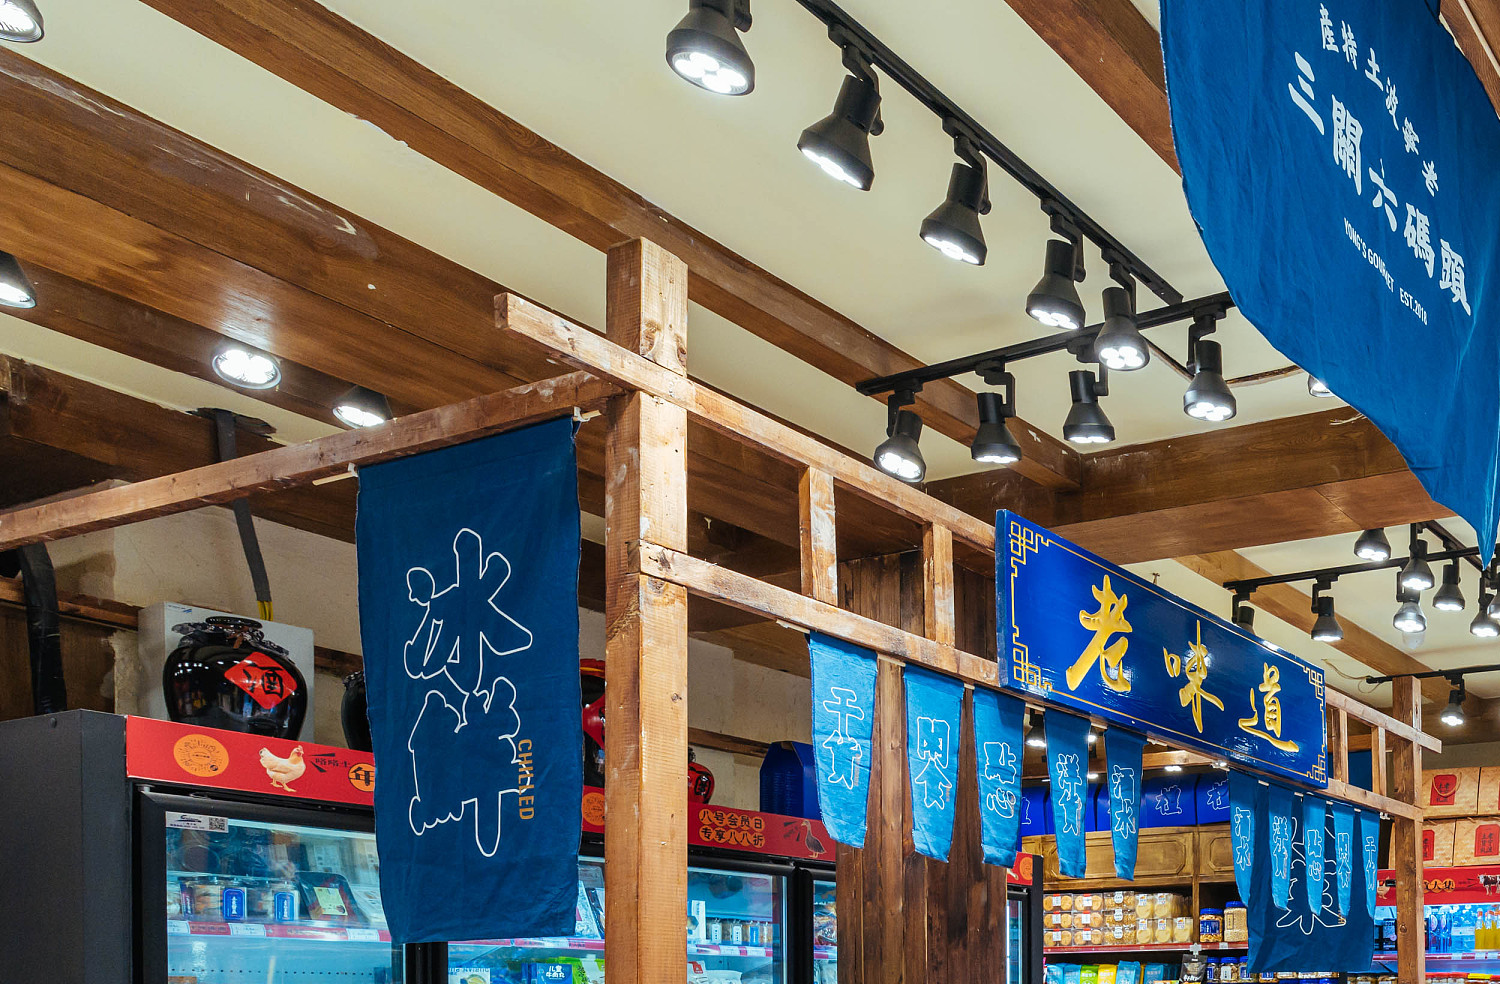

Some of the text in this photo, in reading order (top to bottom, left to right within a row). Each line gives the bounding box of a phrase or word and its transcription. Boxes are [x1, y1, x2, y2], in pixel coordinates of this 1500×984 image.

[1288, 51, 1471, 316] 三關六碼頭
[1343, 218, 1366, 259] YONG'S
[1400, 288, 1428, 325] EST.2018
[243, 664, 284, 699] 酒
[1066, 575, 1300, 754] 老味道
[517, 738, 535, 821] CHILLED
[1111, 764, 1136, 839] 酒水
[700, 811, 763, 829] 八号会员日
[701, 828, 764, 846] 专享八八折
